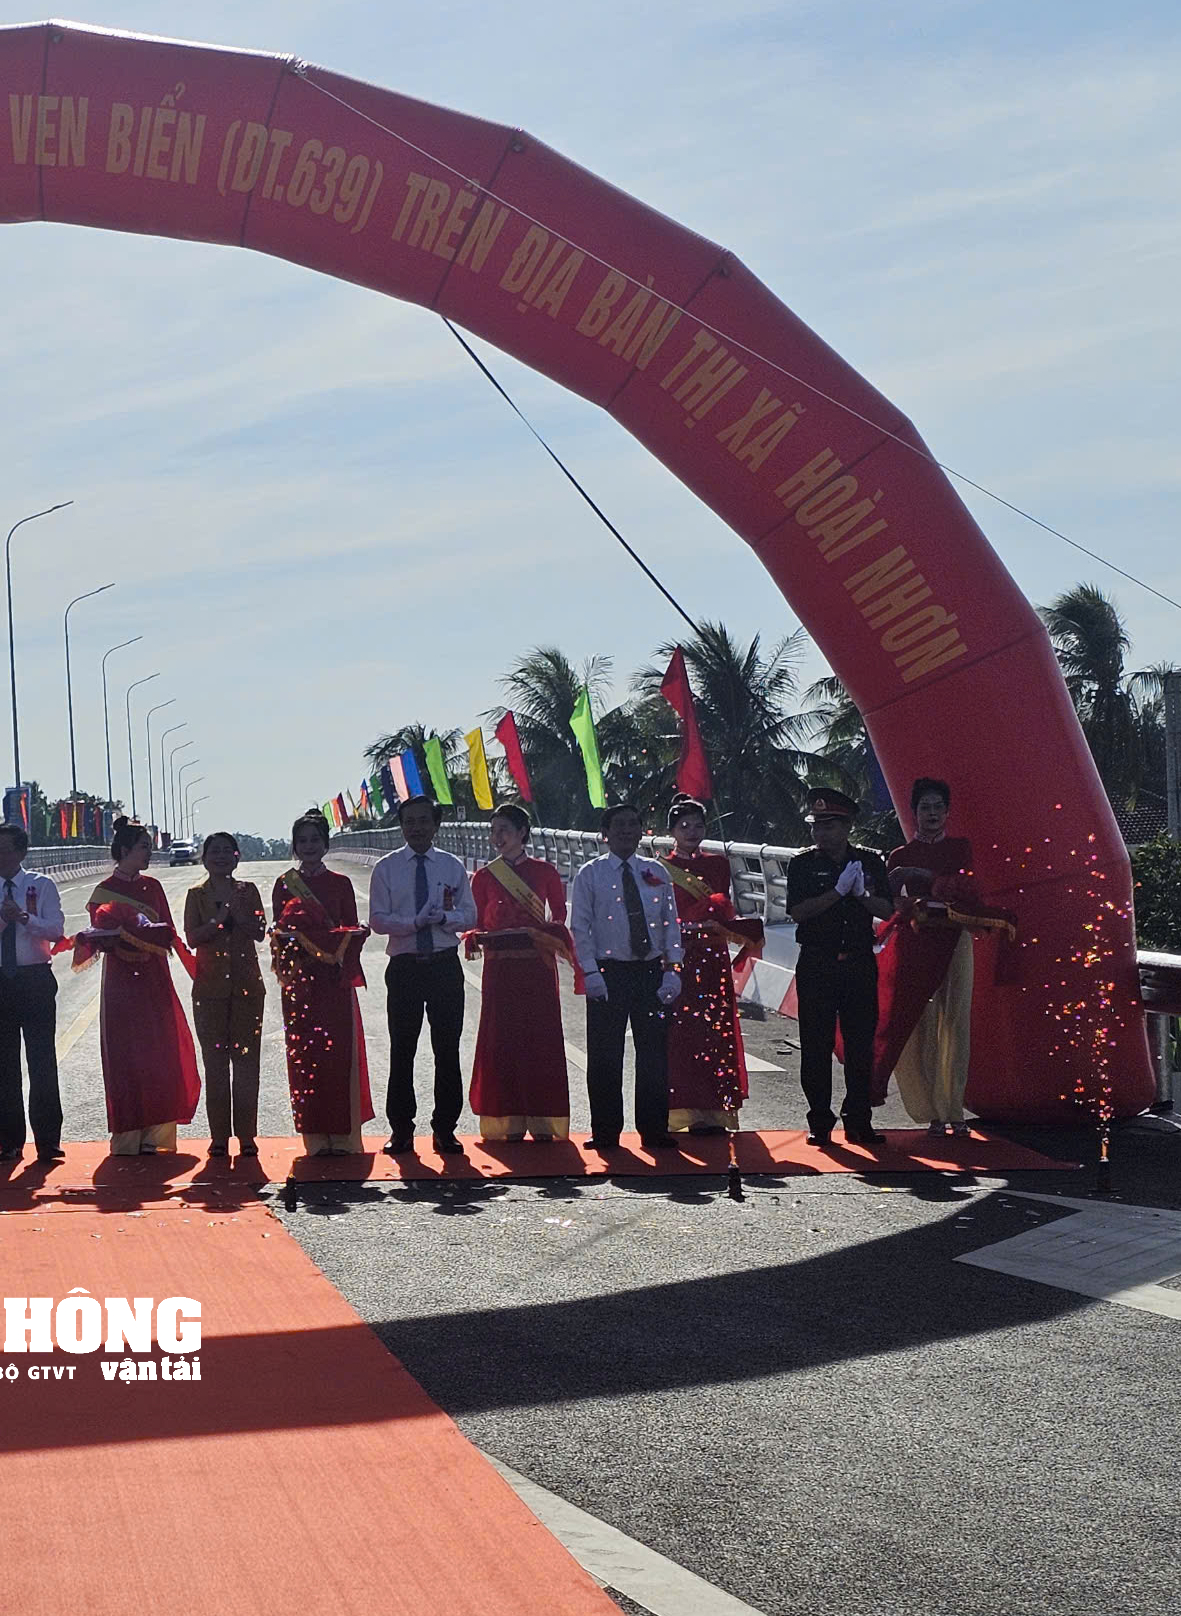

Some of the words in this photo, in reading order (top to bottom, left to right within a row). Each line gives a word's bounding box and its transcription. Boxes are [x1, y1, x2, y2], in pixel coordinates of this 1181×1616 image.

[8, 93, 90, 168] VEN
[104, 81, 207, 185] BIỂN
[217, 119, 385, 236] (ĐT.639)
[391, 171, 511, 274] TRÊN
[497, 223, 586, 320] ĐỊA
[575, 266, 683, 371] BÀN
[659, 328, 749, 430] THỊ
[715, 386, 808, 474] XÃ
[773, 446, 889, 565] HOÀI
[842, 543, 968, 684] NHƠN
